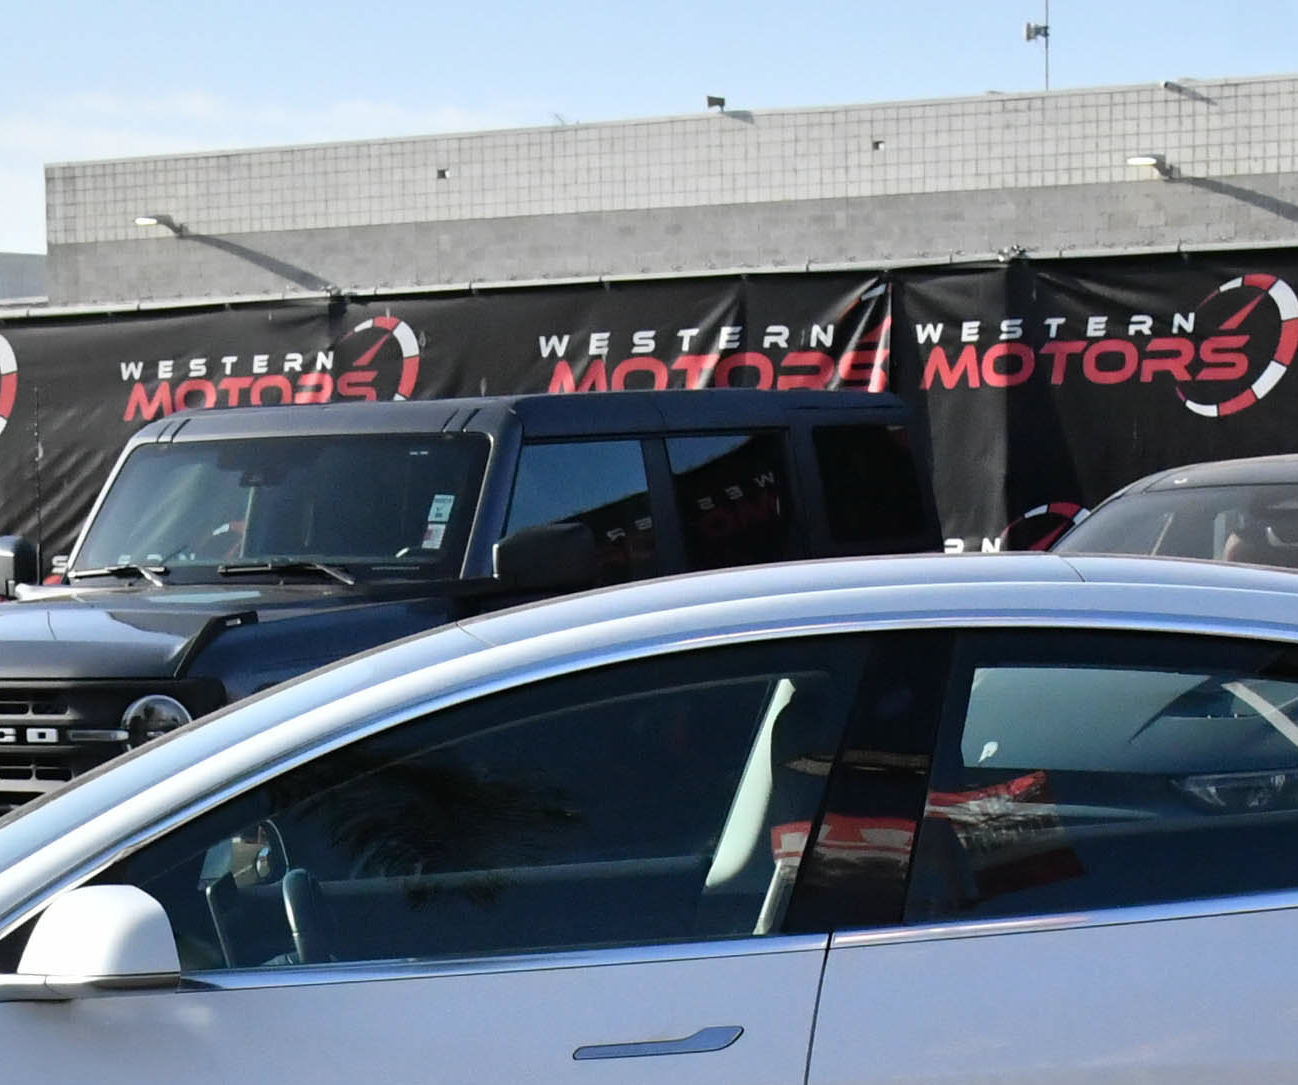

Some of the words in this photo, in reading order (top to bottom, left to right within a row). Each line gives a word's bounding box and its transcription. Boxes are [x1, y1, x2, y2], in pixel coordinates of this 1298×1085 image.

[539, 323, 835, 358] WESTERN
[916, 312, 1196, 344] WESTERN
[120, 351, 334, 381] WESTERN
[547, 349, 891, 393] MOTORS
[920, 335, 1250, 391] MOTORS
[123, 371, 378, 421] MOTORS
